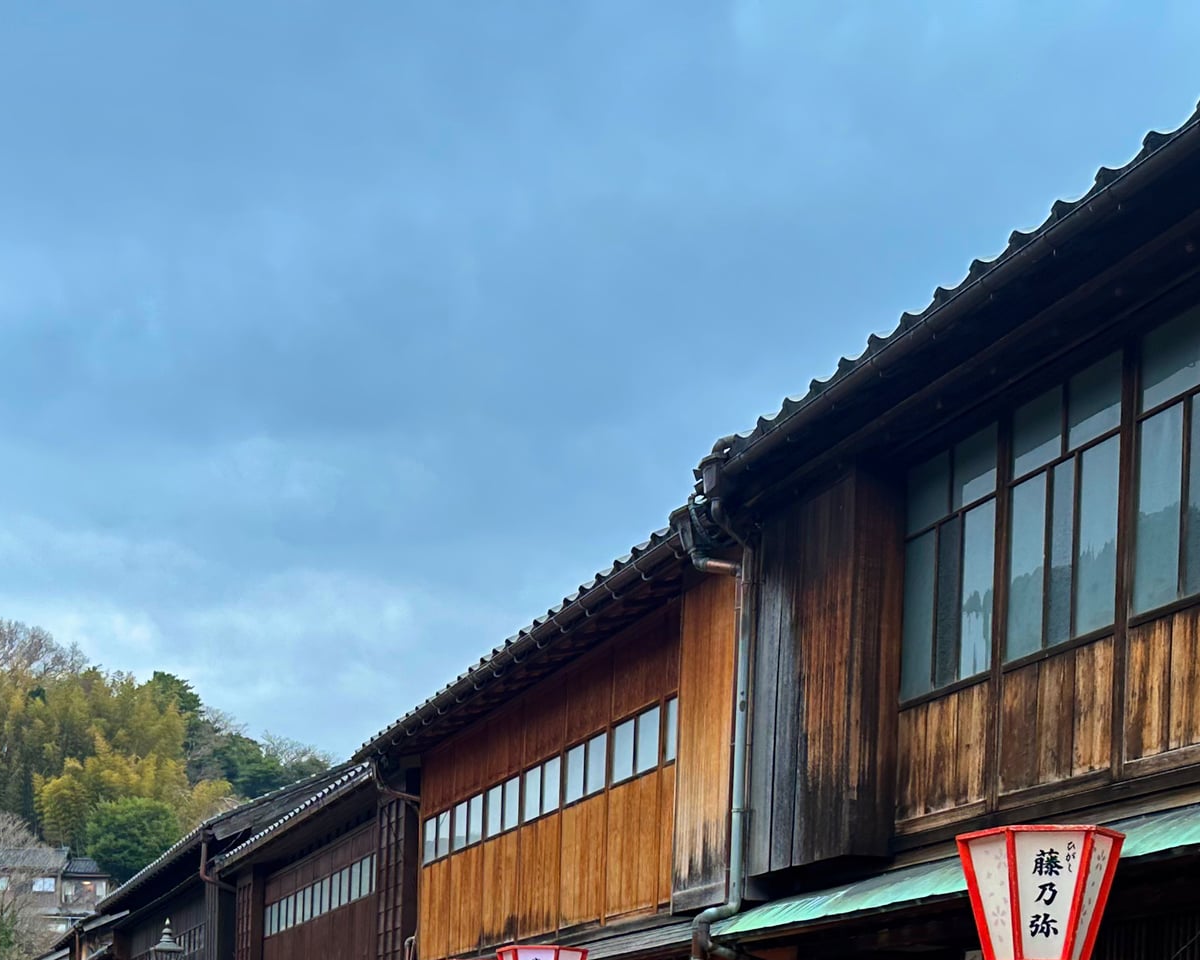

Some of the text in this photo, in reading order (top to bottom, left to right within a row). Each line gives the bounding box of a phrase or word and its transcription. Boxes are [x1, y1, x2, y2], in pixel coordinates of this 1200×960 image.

[1065, 841, 1076, 873] ひがし
[1029, 848, 1064, 938] 藤乃弥
